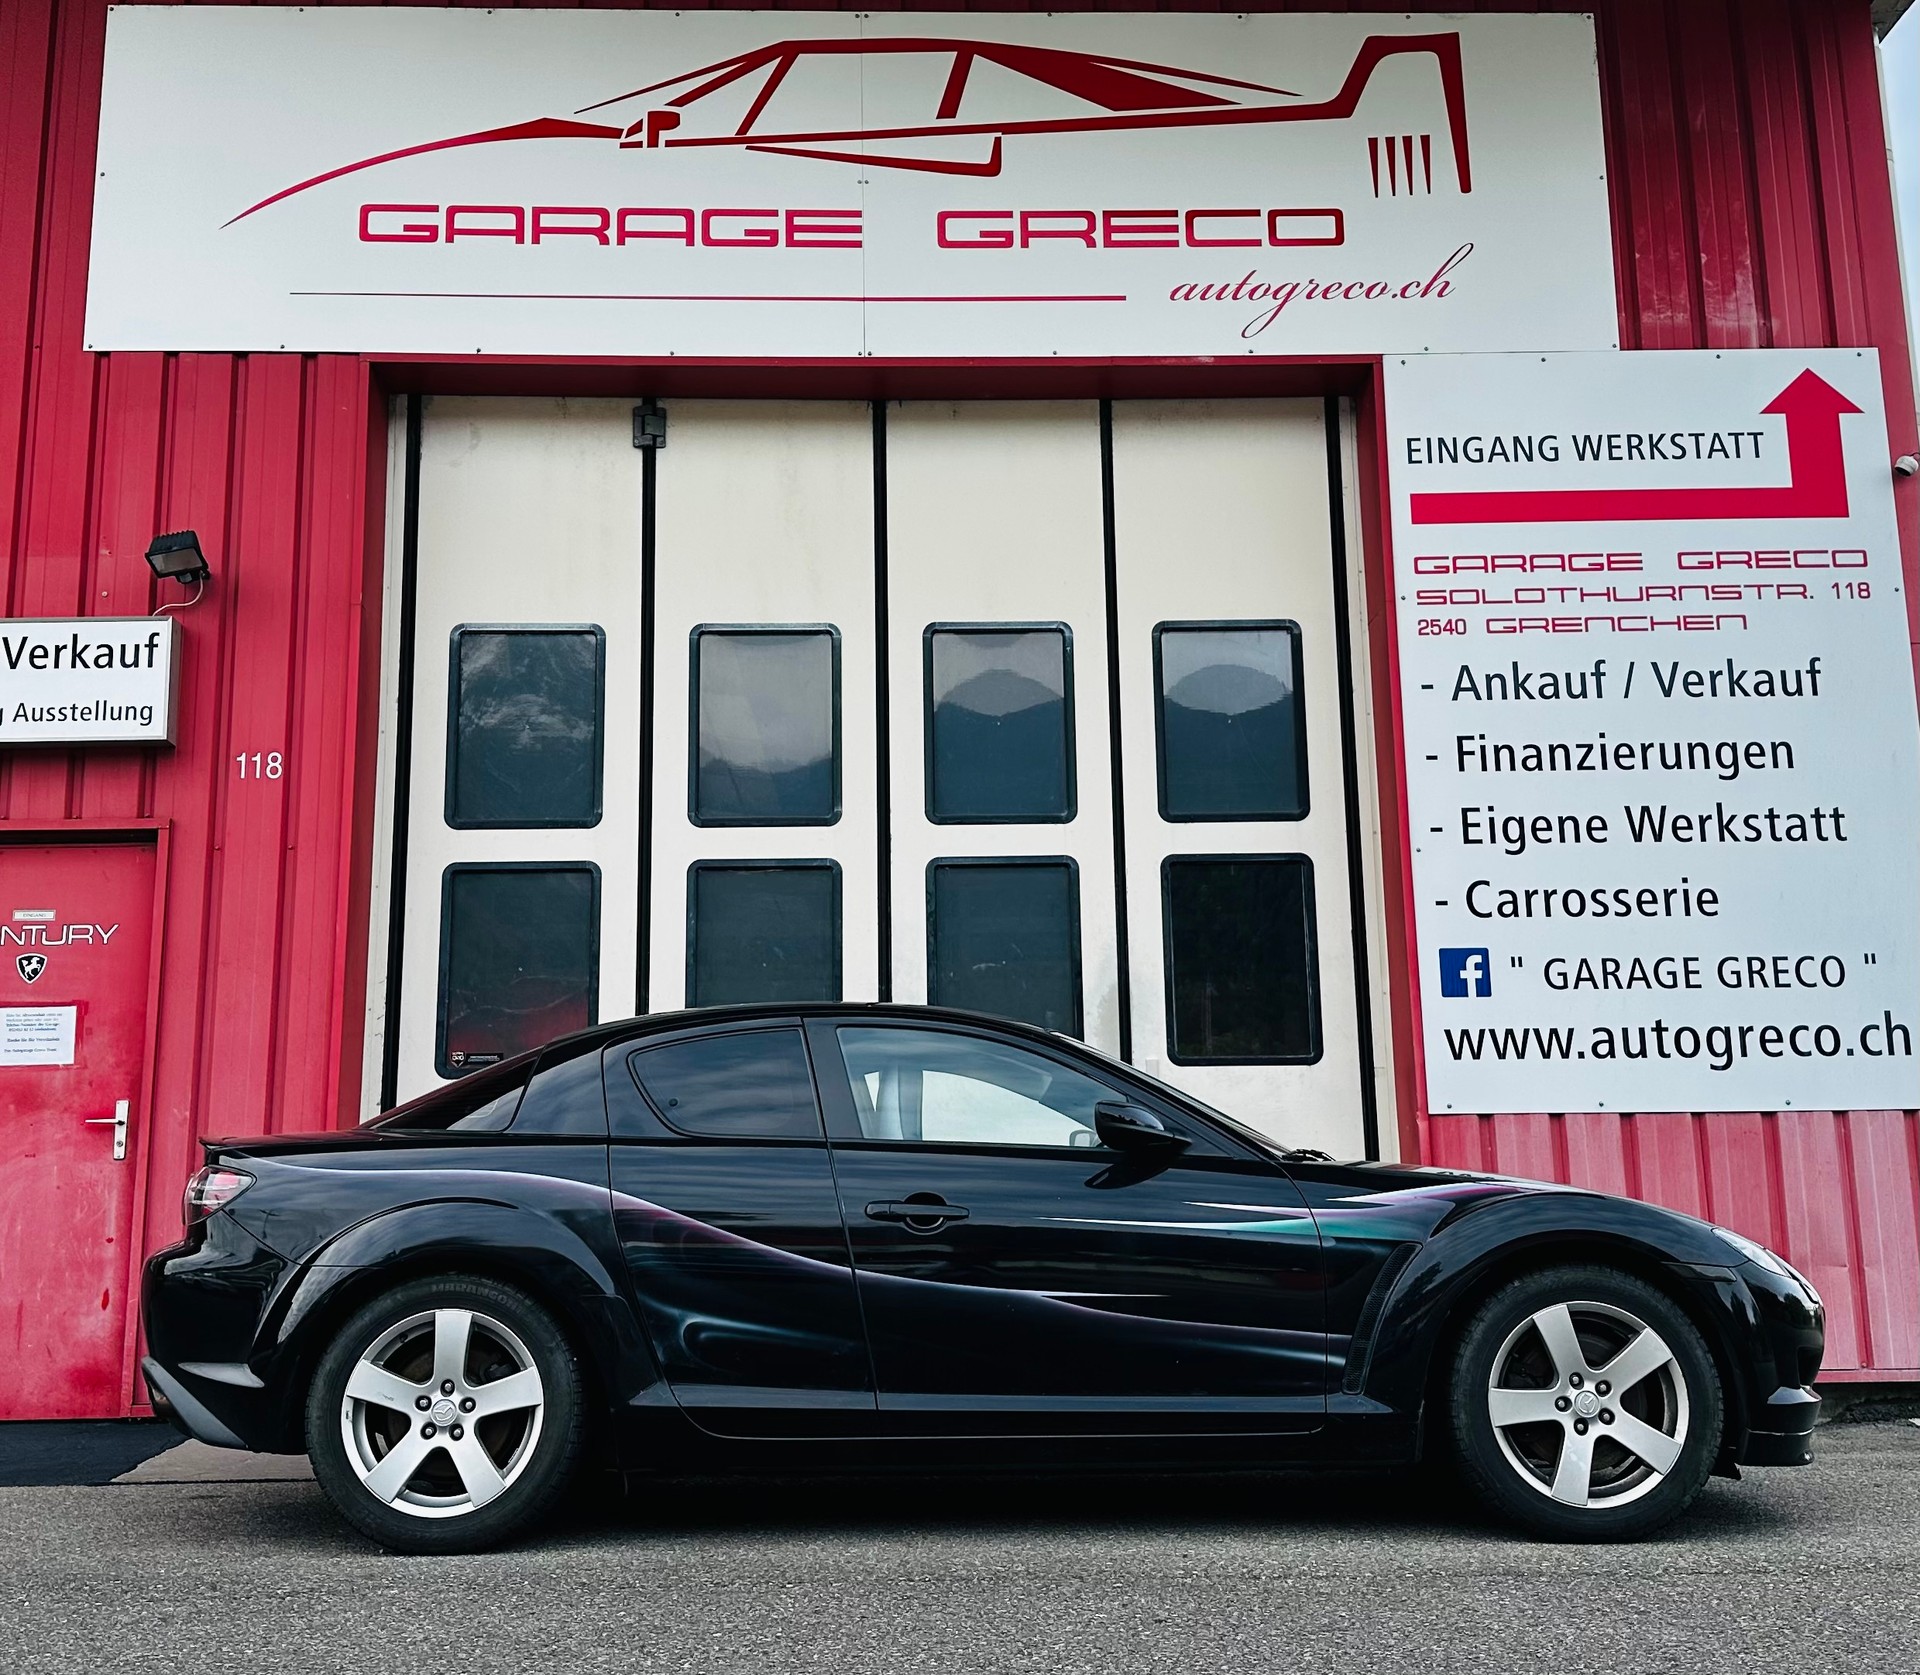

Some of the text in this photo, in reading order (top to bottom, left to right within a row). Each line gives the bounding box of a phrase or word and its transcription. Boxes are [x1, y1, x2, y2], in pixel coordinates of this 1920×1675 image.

[359, 204, 1345, 250] GARAGE GRECO
[1169, 241, 1474, 339] autogreco.ch
[1406, 431, 1764, 465] EINGANG WERKSTATT
[1413, 549, 1868, 575] GARAGE GRECO
[1416, 581, 1871, 605] SOLOTHURNSTR. 118
[1417, 615, 1748, 636] 2540 GRENCHEN
[2, 632, 160, 670] Verkauf
[1451, 659, 1607, 702] Ankauf
[1623, 661, 1636, 699] /
[1650, 656, 1822, 698] Verkauf
[12, 699, 153, 727] Ausstellung
[236, 751, 283, 779] 118
[1456, 732, 1795, 781] Finanzierungen
[1460, 805, 1608, 856] Eigene
[1624, 802, 1848, 843] Werkstatt
[1465, 876, 1719, 919] Carrosserie
[1543, 956, 1703, 990] GARAGE
[1717, 955, 1846, 989] GRECO
[1443, 1010, 1912, 1071] www.autogreco.ch
